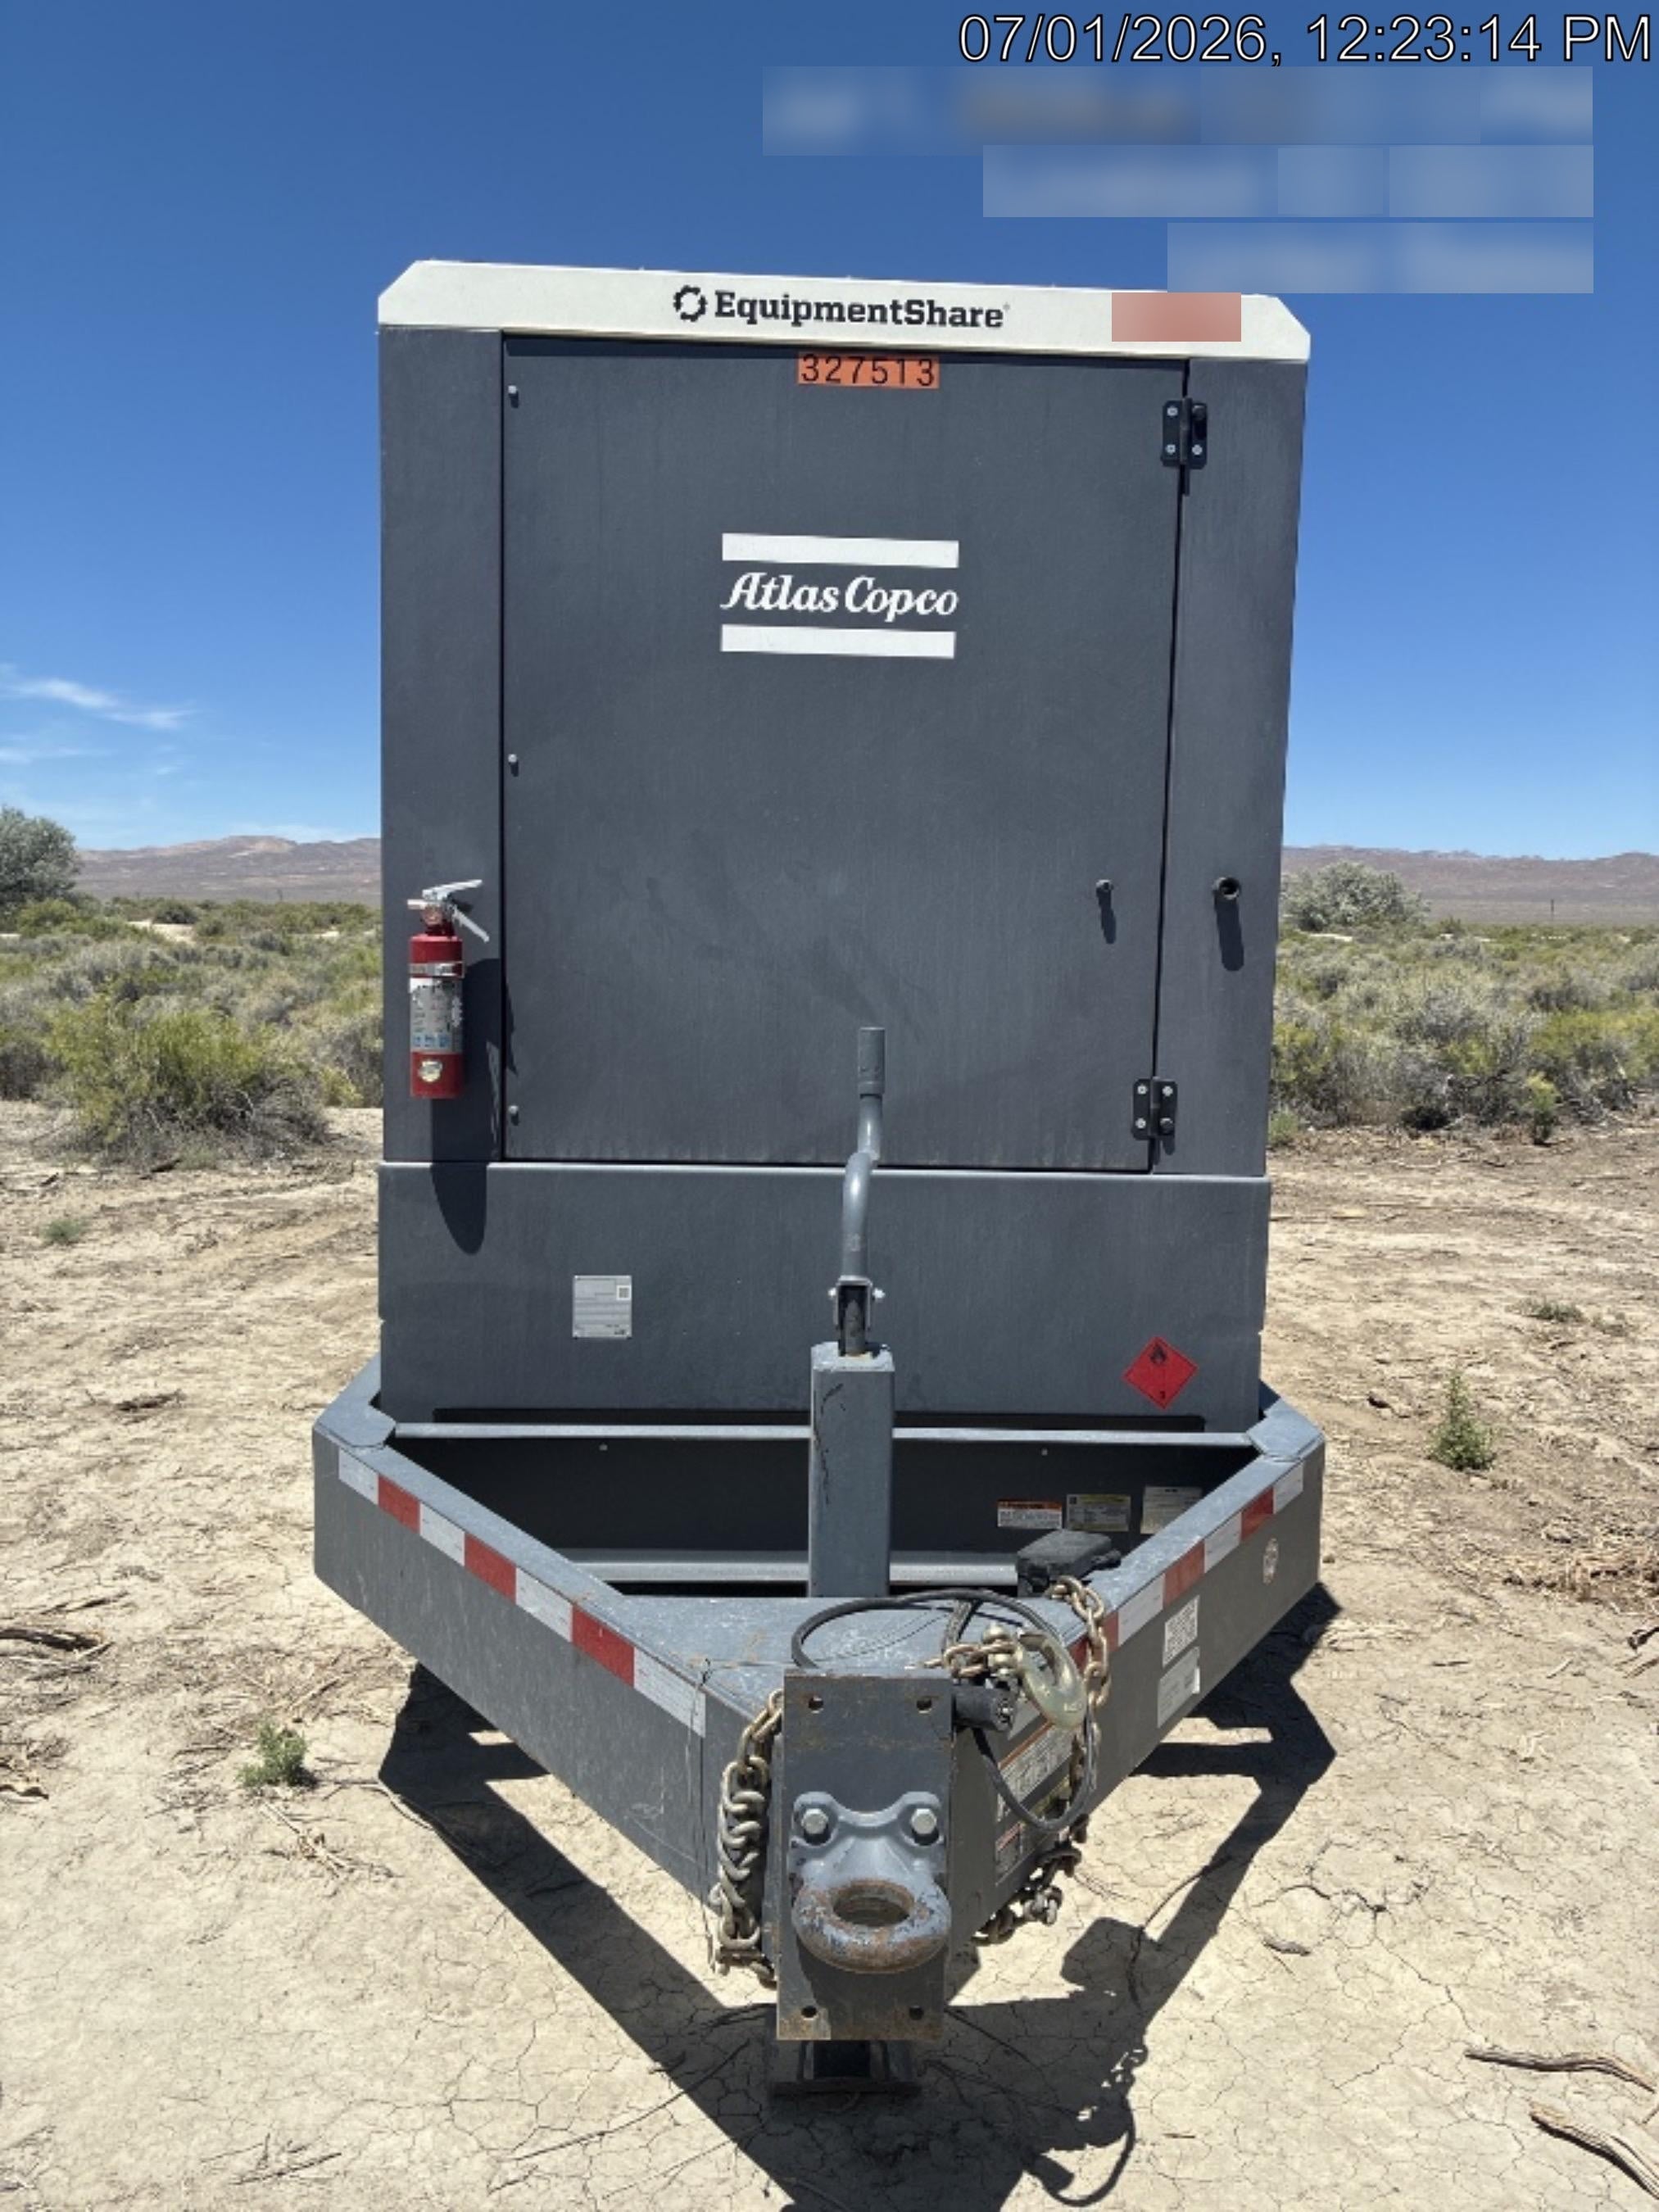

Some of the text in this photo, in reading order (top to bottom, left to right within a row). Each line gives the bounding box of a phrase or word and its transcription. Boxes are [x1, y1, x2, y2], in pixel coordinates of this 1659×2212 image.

[714, 290, 1004, 329] EquipmentShare
[800, 353, 935, 387] 327513
[720, 572, 959, 623] Atlas Copco
